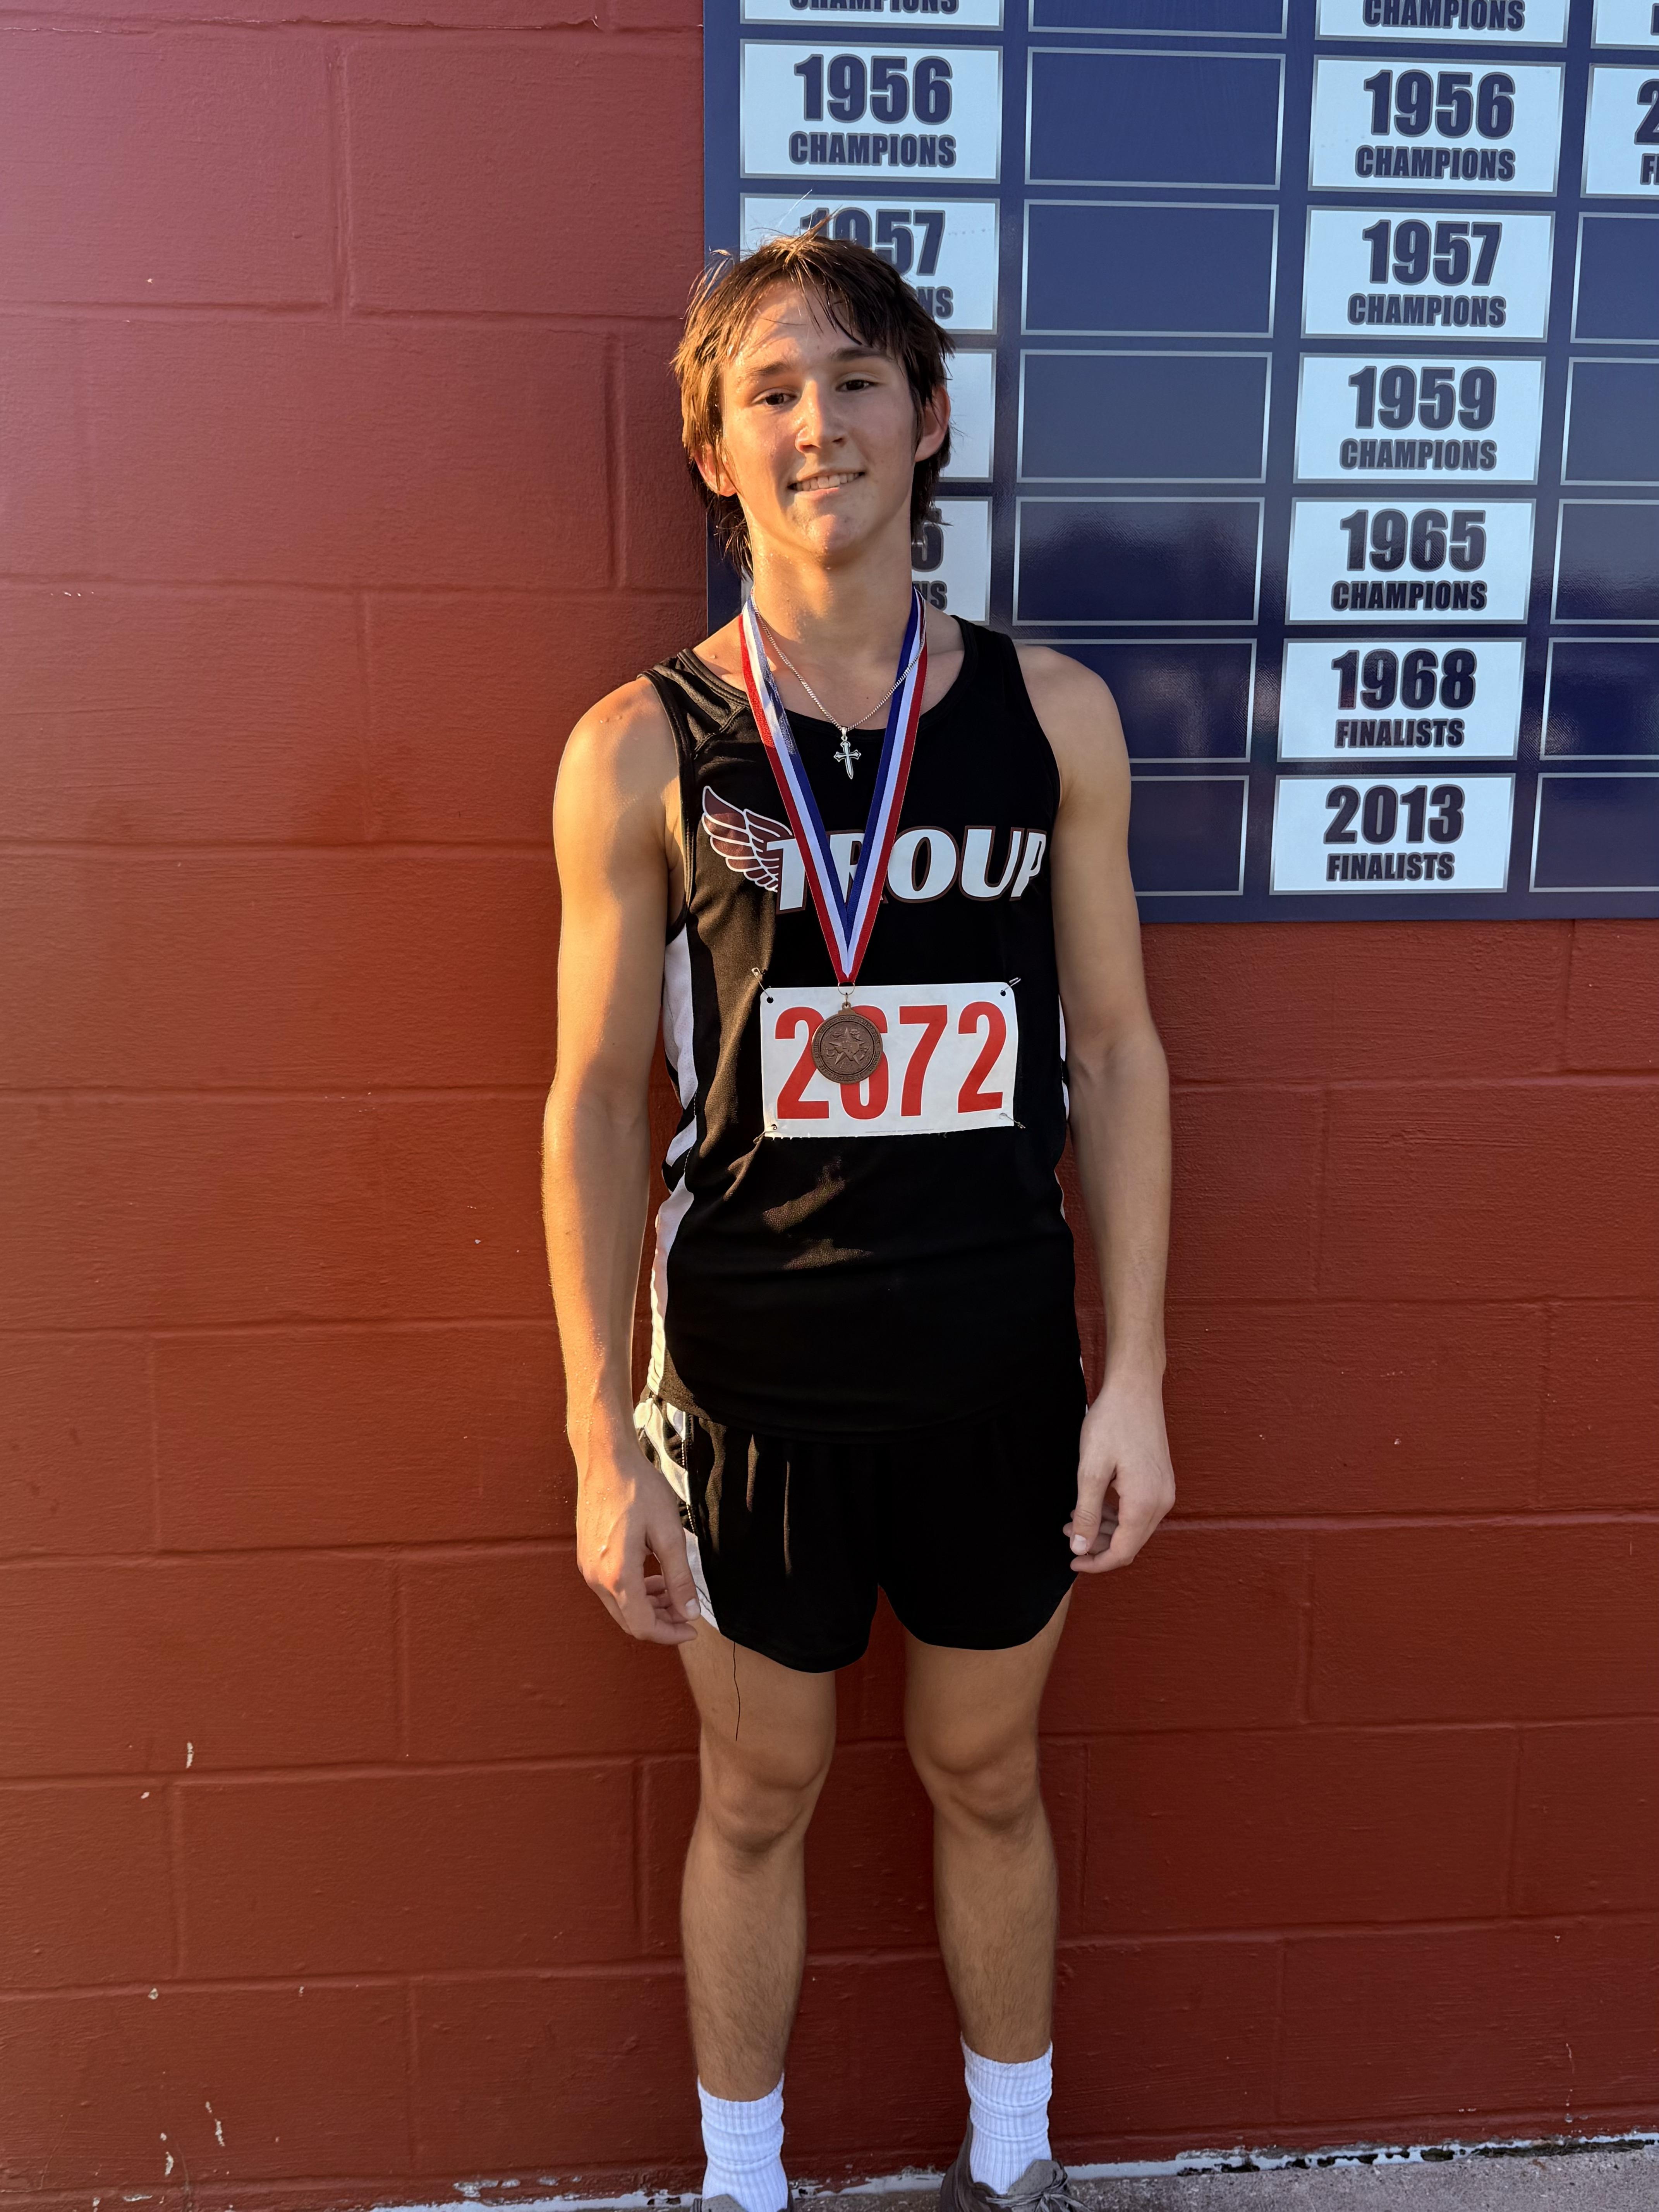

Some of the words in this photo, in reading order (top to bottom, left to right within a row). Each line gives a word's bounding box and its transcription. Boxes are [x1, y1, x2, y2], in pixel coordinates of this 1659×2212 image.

[1363, 0, 1525, 31] CHAMPIONS
[793, 53, 953, 125] 1956
[1363, 69, 1516, 140] 1956
[788, 131, 957, 168] CHAMPIONS
[1355, 145, 1516, 181] CHAMPIONS
[1362, 219, 1503, 286] 1957
[1348, 293, 1506, 328] CHAMPIONS
[1348, 365, 1497, 431] 1959
[1339, 438, 1497, 471] CHAMPIONS
[1340, 509, 1487, 572] 1965
[1331, 580, 1488, 611] CHAMPIONS
[1331, 648, 1477, 711] 1968
[1334, 718, 1465, 749] FINALISTS
[1323, 784, 1465, 845] 2013
[1326, 852, 1455, 882] FINALISTS
